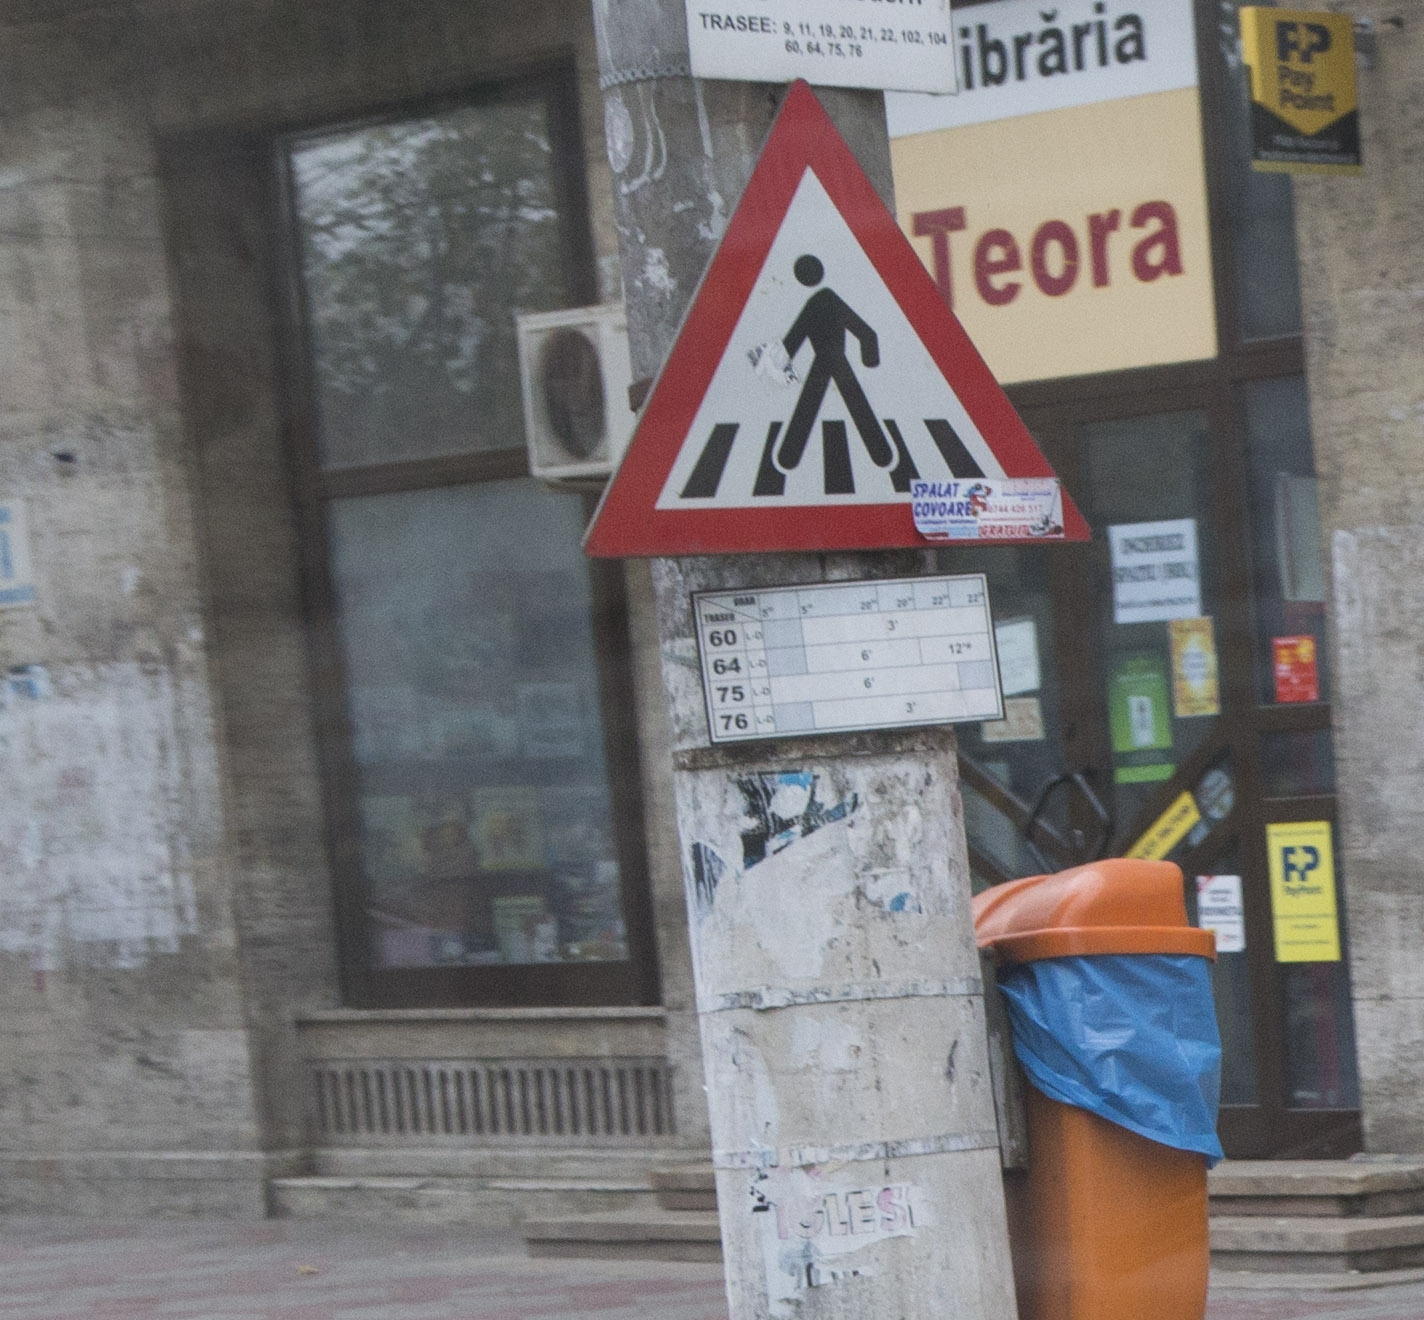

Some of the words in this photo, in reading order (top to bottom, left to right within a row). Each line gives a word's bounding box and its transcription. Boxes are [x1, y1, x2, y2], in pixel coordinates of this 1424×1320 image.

[699, 13, 777, 33] TRASEE:
[800, 23, 815, 38] 11,
[820, 24, 836, 39] 19,
[840, 25, 856, 40] 20,
[860, 26, 876, 41] 21,
[881, 28, 897, 43] 22,
[902, 30, 924, 44] 102,
[929, 31, 947, 45] 104
[785, 39, 802, 56] 60,
[806, 41, 824, 57] 64,
[828, 43, 845, 58] 75,
[849, 44, 863, 58] 76
[958, 2, 1147, 91] ibrăria
[911, 199, 1185, 310] Teora
[913, 482, 960, 499] SPALAT
[914, 501, 971, 517] COVOARE
[709, 630, 737, 647] 60
[713, 657, 742, 675] 64
[716, 685, 745, 703] 75
[720, 713, 749, 731] 76
